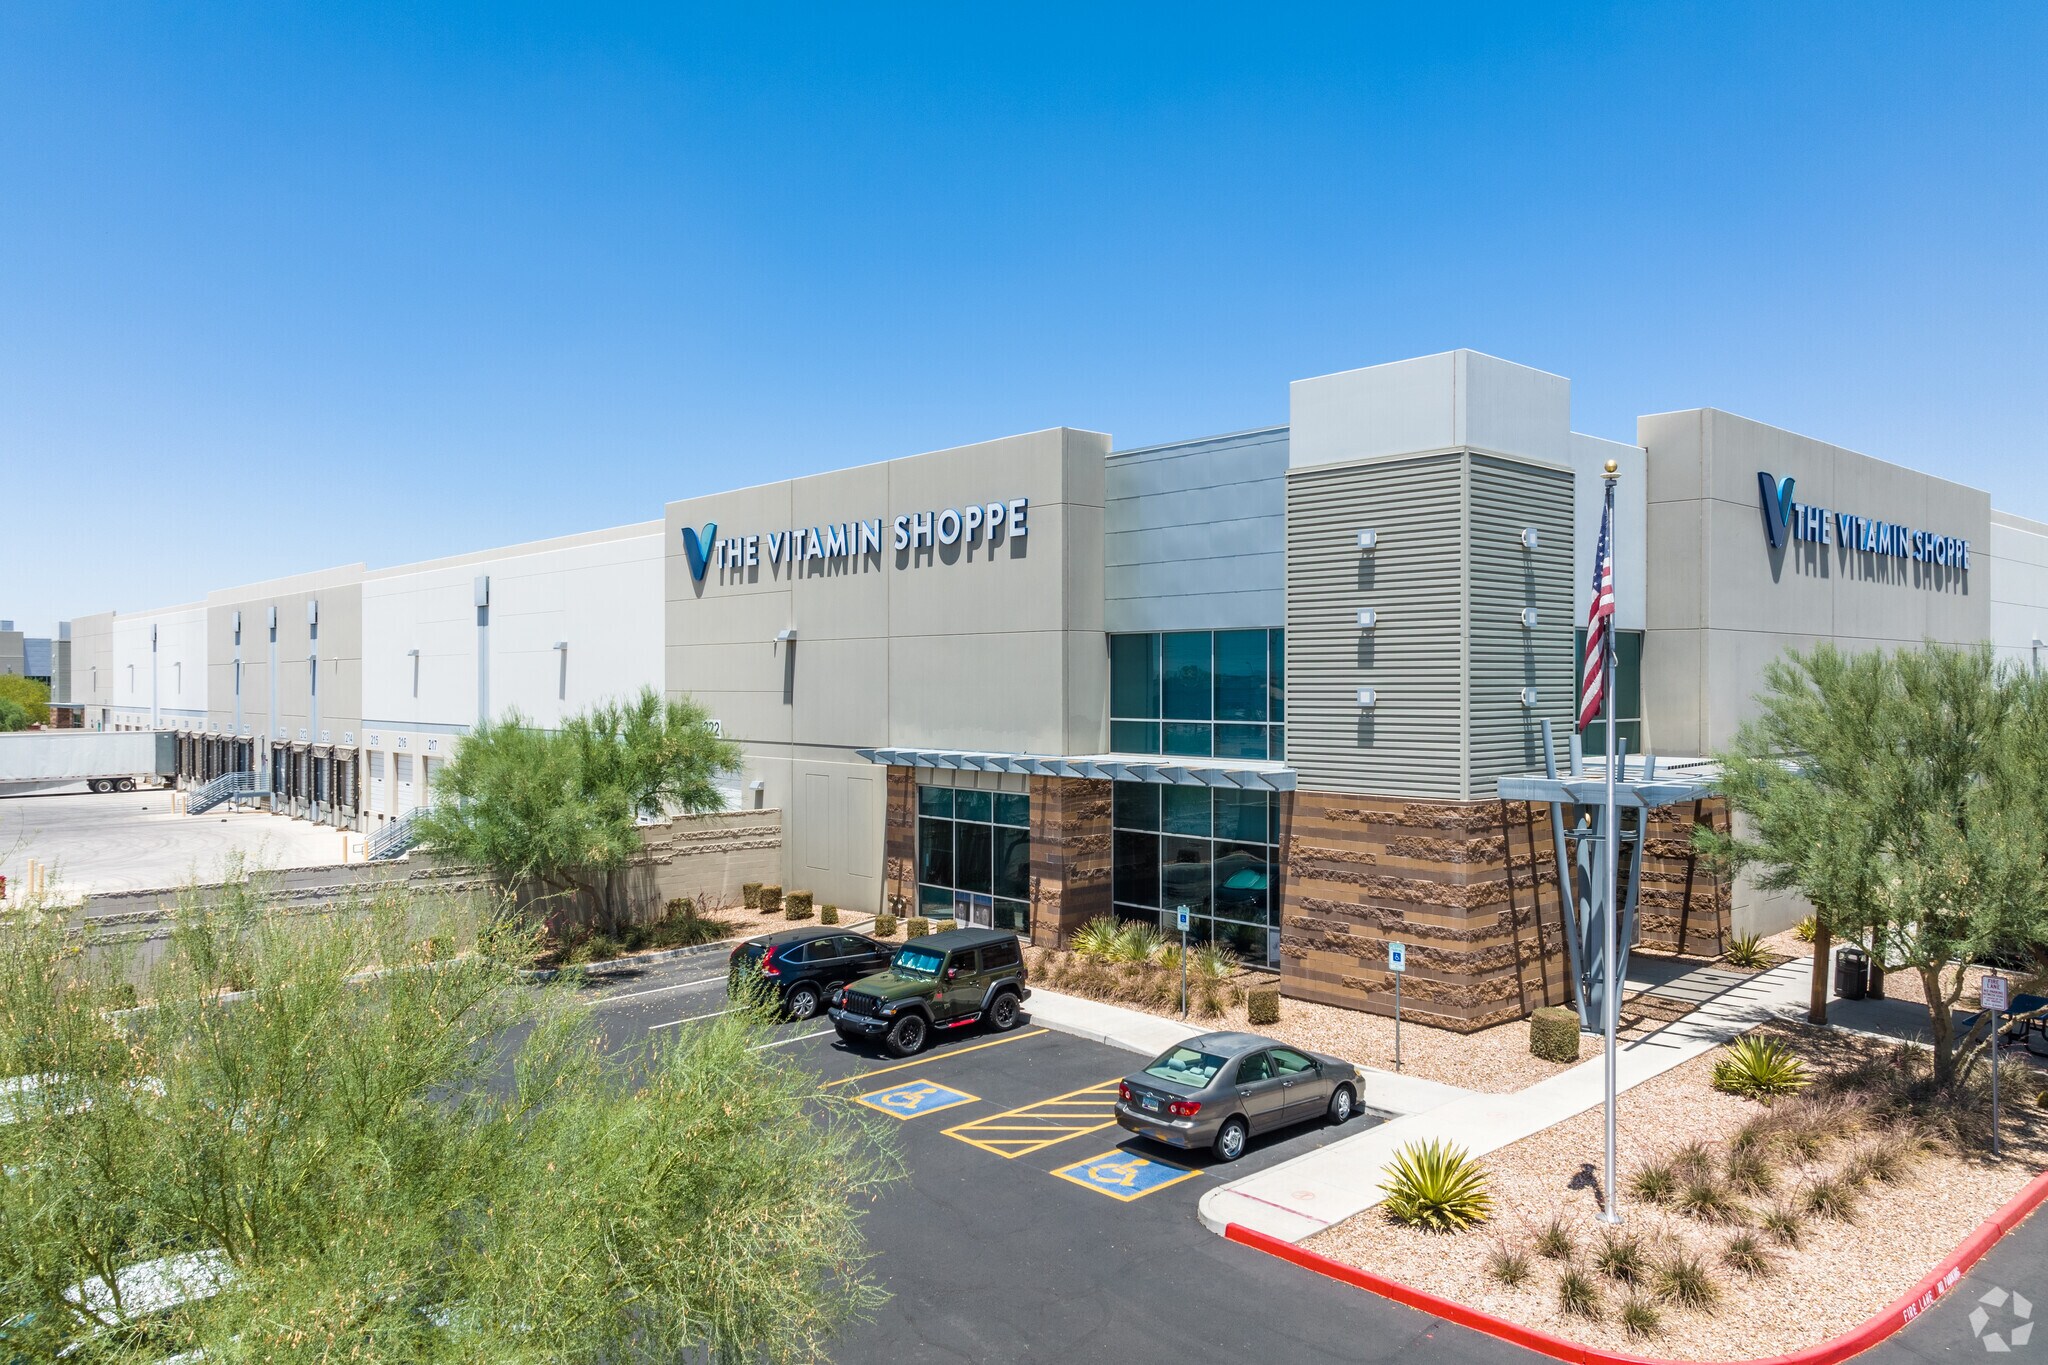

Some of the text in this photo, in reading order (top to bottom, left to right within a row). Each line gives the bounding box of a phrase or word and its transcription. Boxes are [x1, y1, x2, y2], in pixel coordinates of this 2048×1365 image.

[715, 534, 760, 569] THE
[767, 518, 882, 564] VITAMIN
[894, 498, 1029, 551] SHOPPE
[1792, 502, 1832, 545] THE
[1835, 512, 1910, 558] VITAMIN
[1912, 529, 1971, 570] SHOPPE
[345, 733, 353, 743] 214
[370, 735, 379, 745] 215
[398, 737, 407, 748] 216
[428, 740, 438, 751] 217
[1902, 1303, 1918, 1322] FIRE
[1918, 1290, 1934, 1311] LANE
